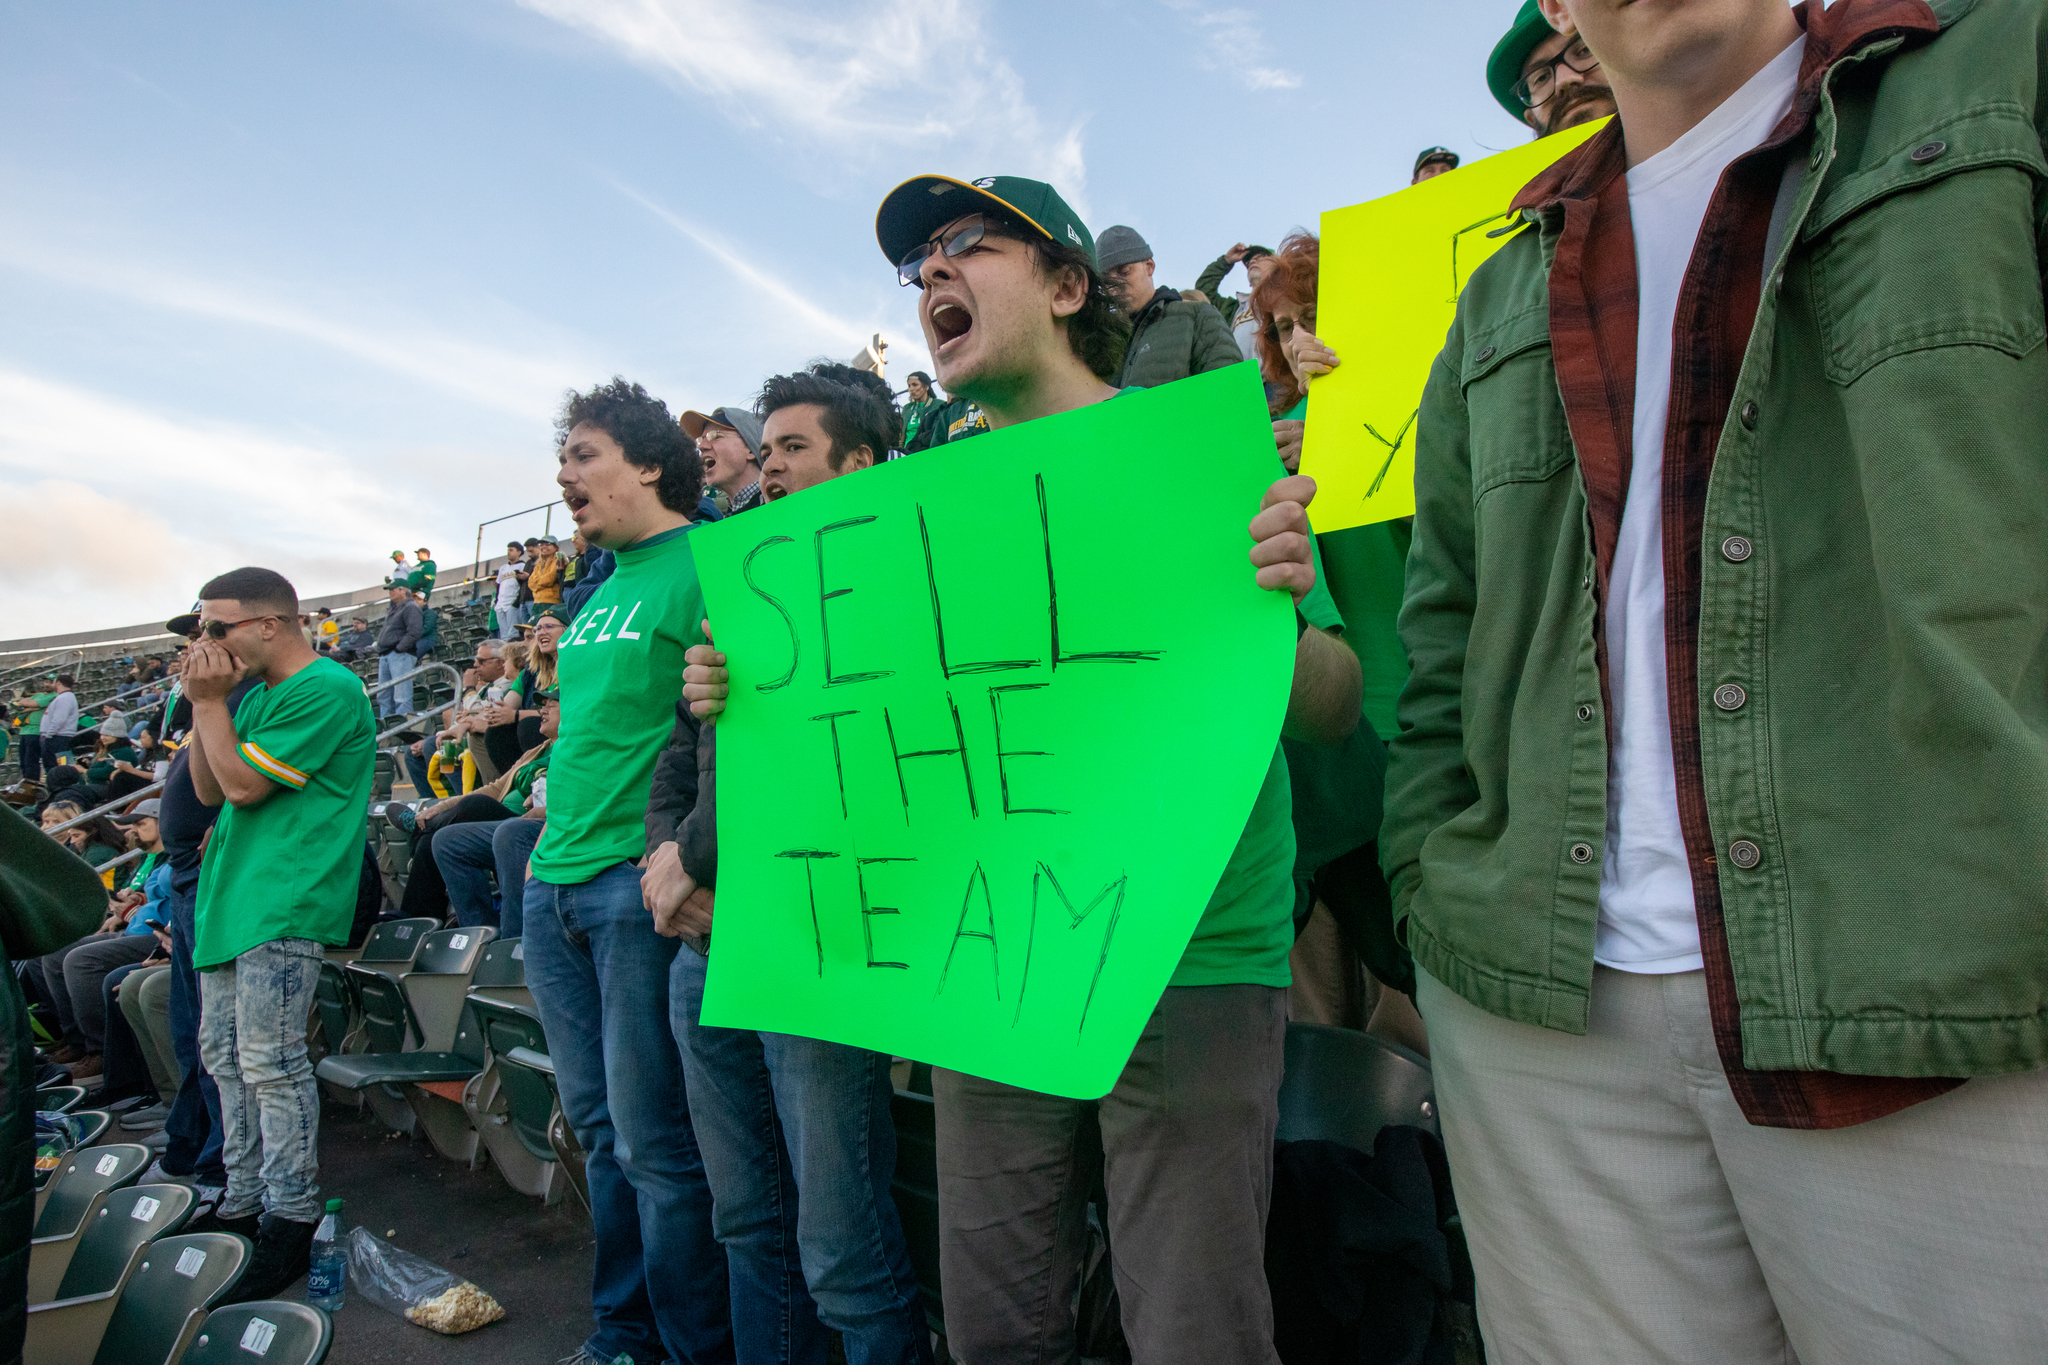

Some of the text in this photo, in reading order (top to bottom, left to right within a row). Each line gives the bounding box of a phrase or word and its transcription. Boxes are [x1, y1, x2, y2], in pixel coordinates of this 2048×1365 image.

[743, 473, 1166, 694] SELL
[557, 601, 642, 649] SELL
[808, 683, 1071, 826] THE
[455, 936, 464, 948] 8
[774, 843, 1127, 1046] TEAM
[102, 1157, 114, 1173] 8
[140, 1199, 153, 1218] 9
[182, 1250, 200, 1273] 10
[249, 1323, 270, 1350] 11
